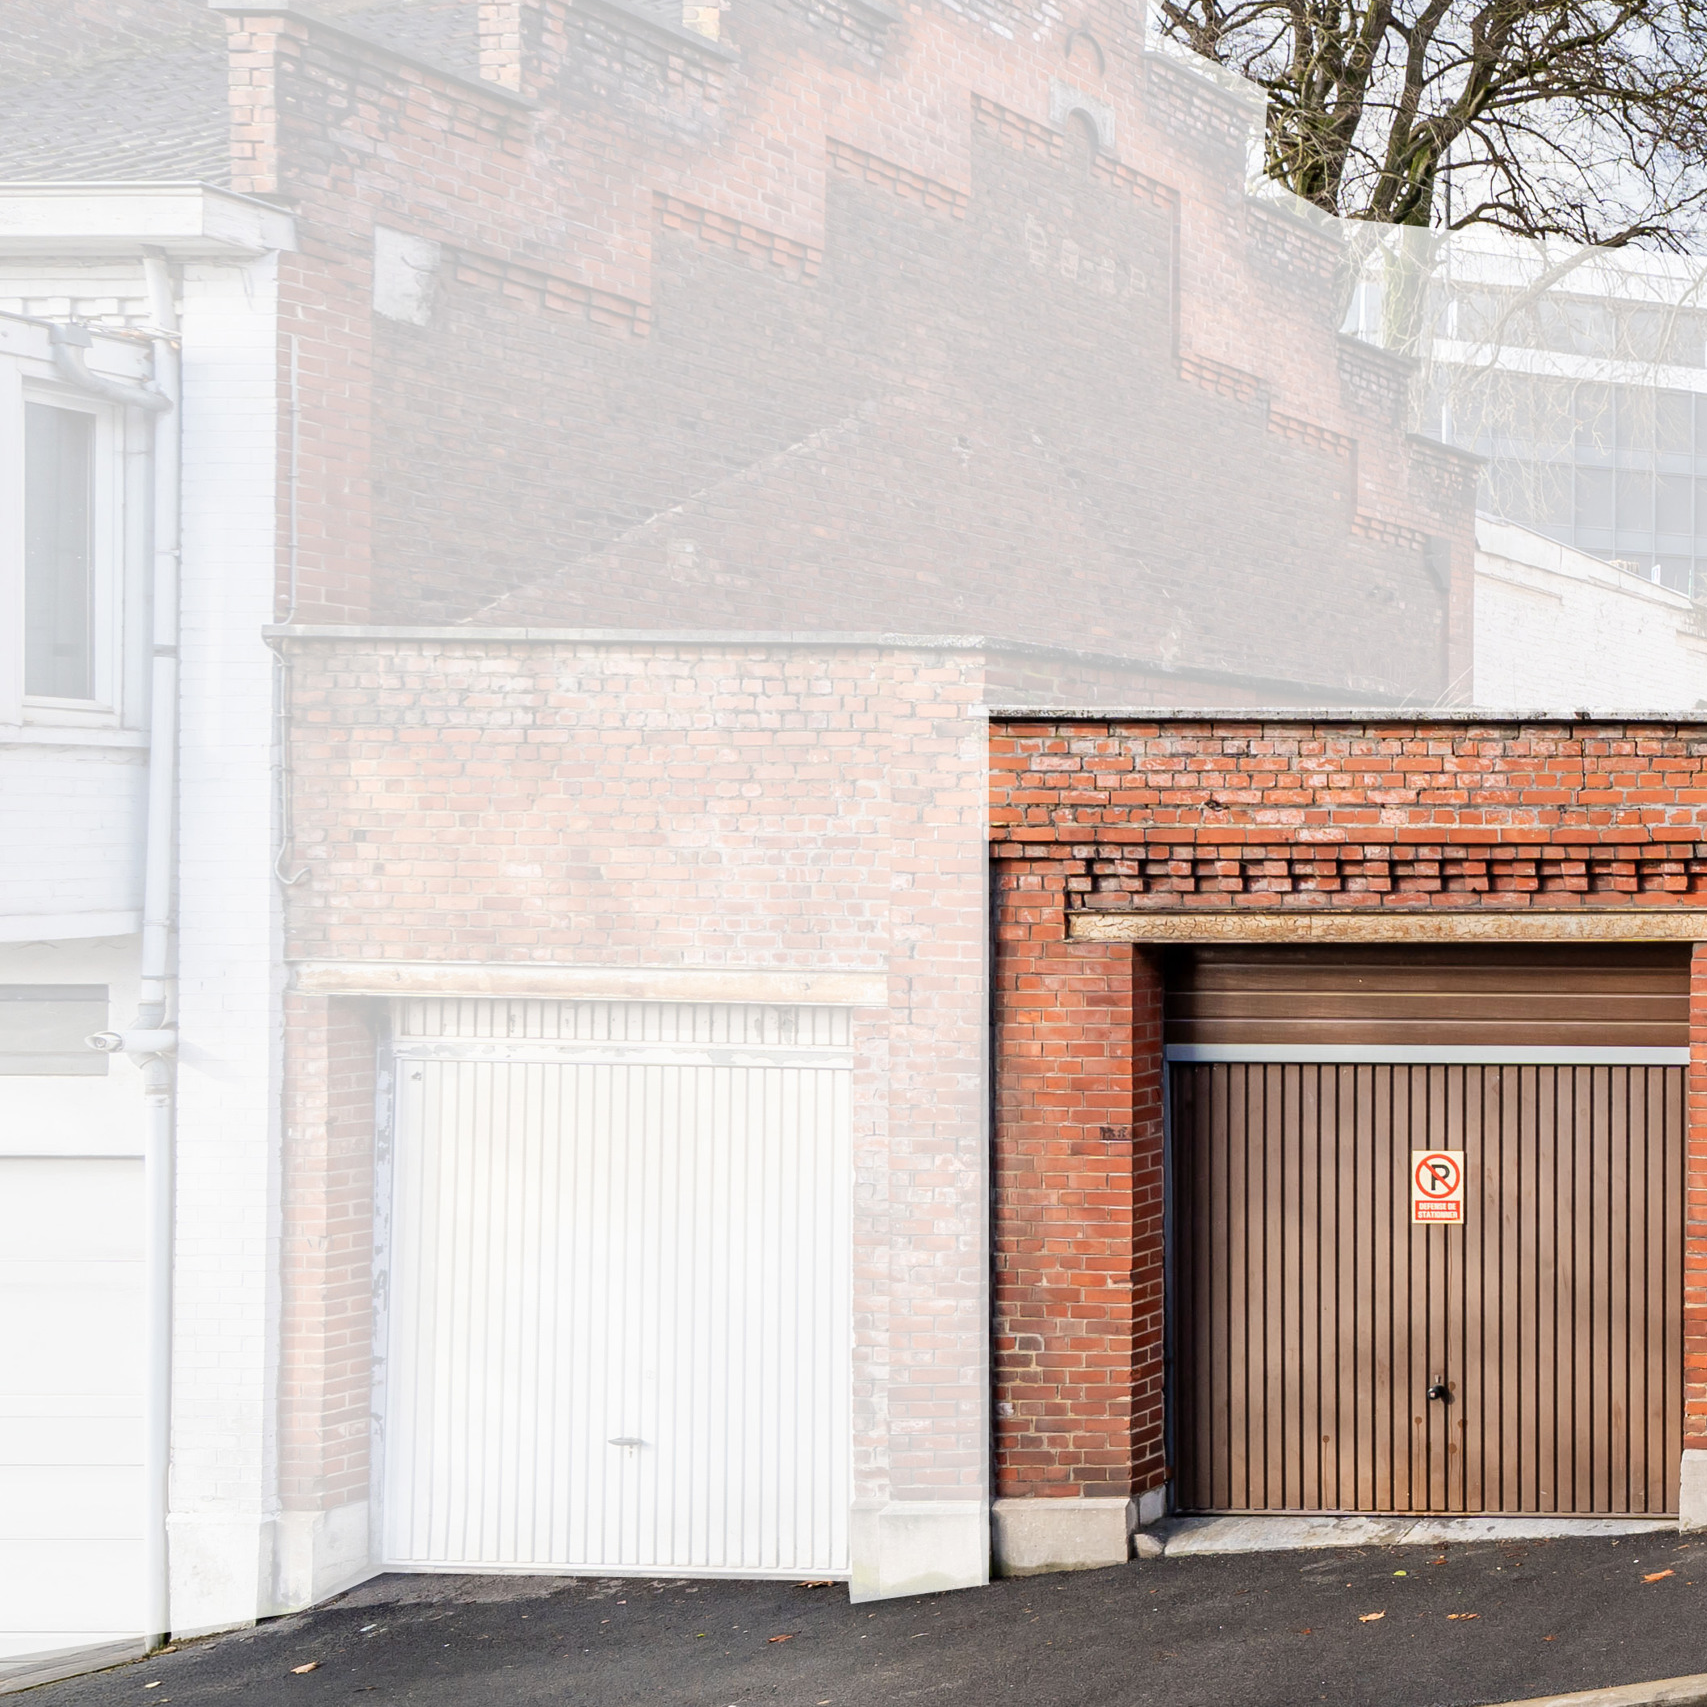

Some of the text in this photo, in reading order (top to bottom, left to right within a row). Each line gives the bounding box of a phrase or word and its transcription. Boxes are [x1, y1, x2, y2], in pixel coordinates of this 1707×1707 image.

[1418, 1202, 1457, 1210] DEFENSE DE
[1417, 1211, 1458, 1219] STATIONNER
